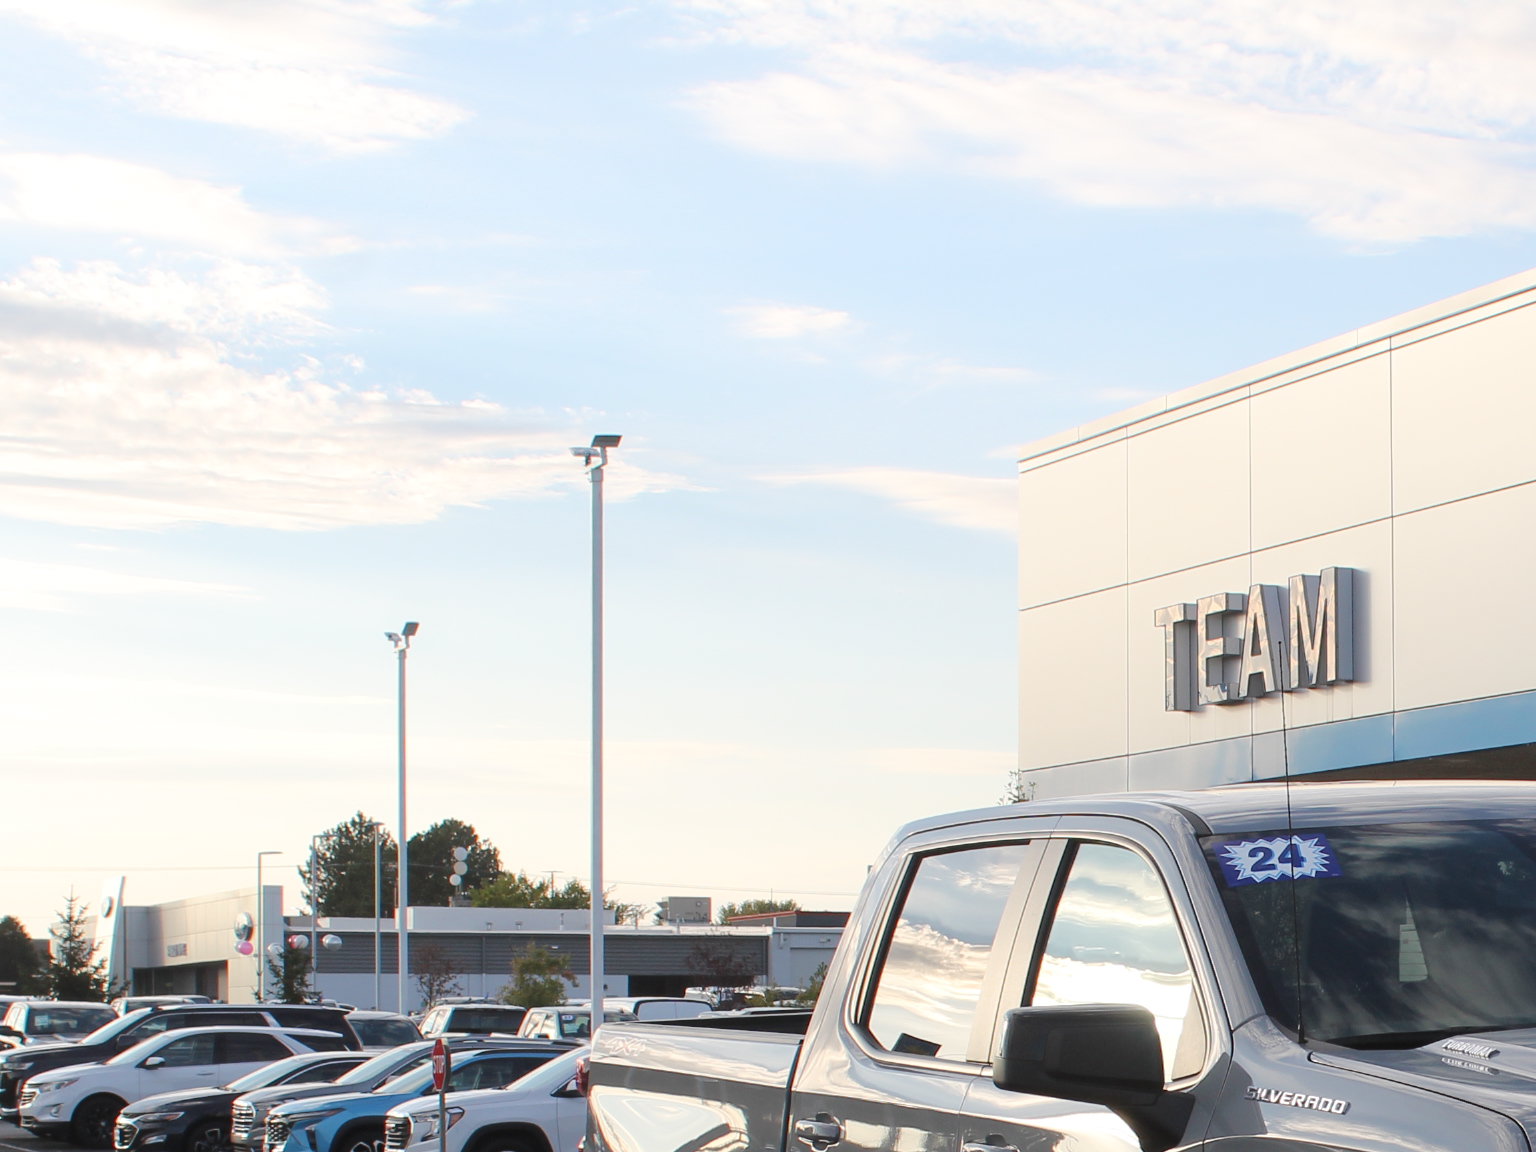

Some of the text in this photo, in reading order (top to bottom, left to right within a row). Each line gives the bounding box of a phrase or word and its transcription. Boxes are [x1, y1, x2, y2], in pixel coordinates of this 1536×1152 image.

[1154, 566, 1353, 712] TEAM
[1248, 843, 1306, 872] 24
[1245, 1086, 1351, 1115] SILVERADO
